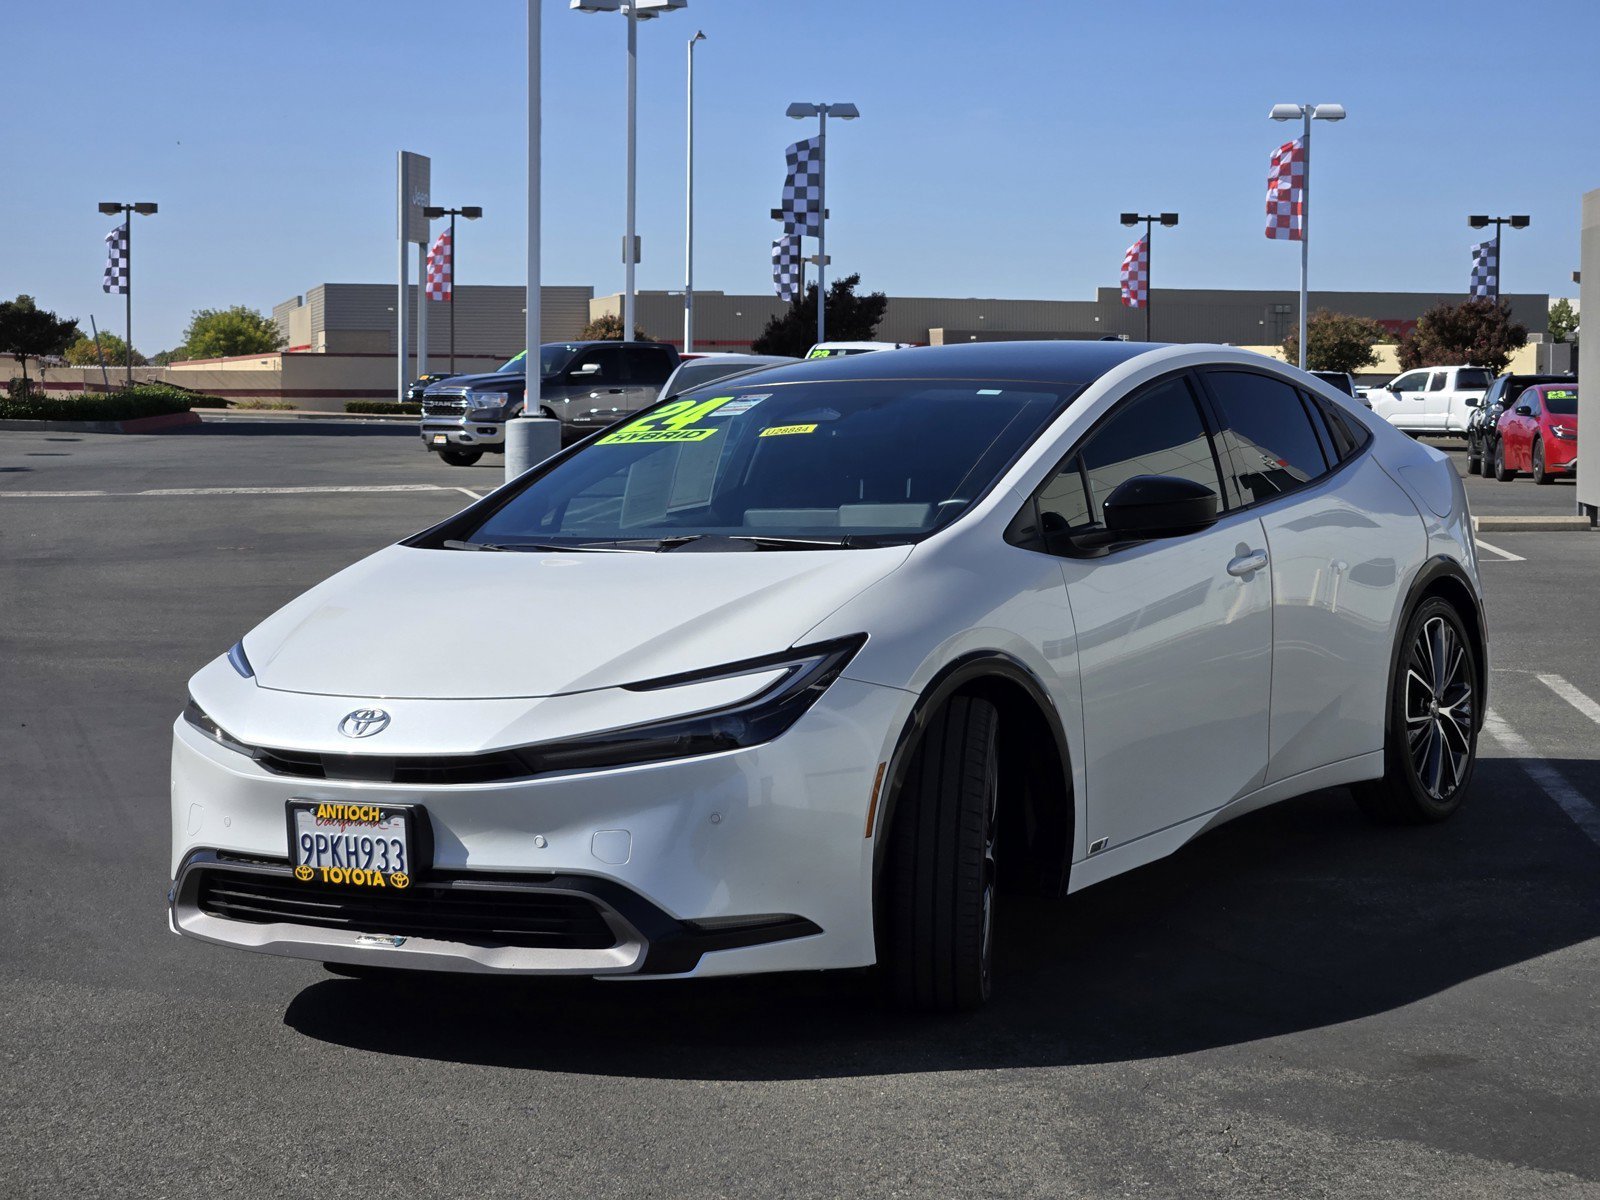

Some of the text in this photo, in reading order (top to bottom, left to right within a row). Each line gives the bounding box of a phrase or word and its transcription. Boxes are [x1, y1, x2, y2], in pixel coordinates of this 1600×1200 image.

[617, 397, 735, 433] 24
[605, 430, 707, 443] HYBRID
[316, 803, 381, 822] ANTIOCH
[300, 833, 406, 873] 9PKH933
[320, 866, 386, 887] TOYOTA
